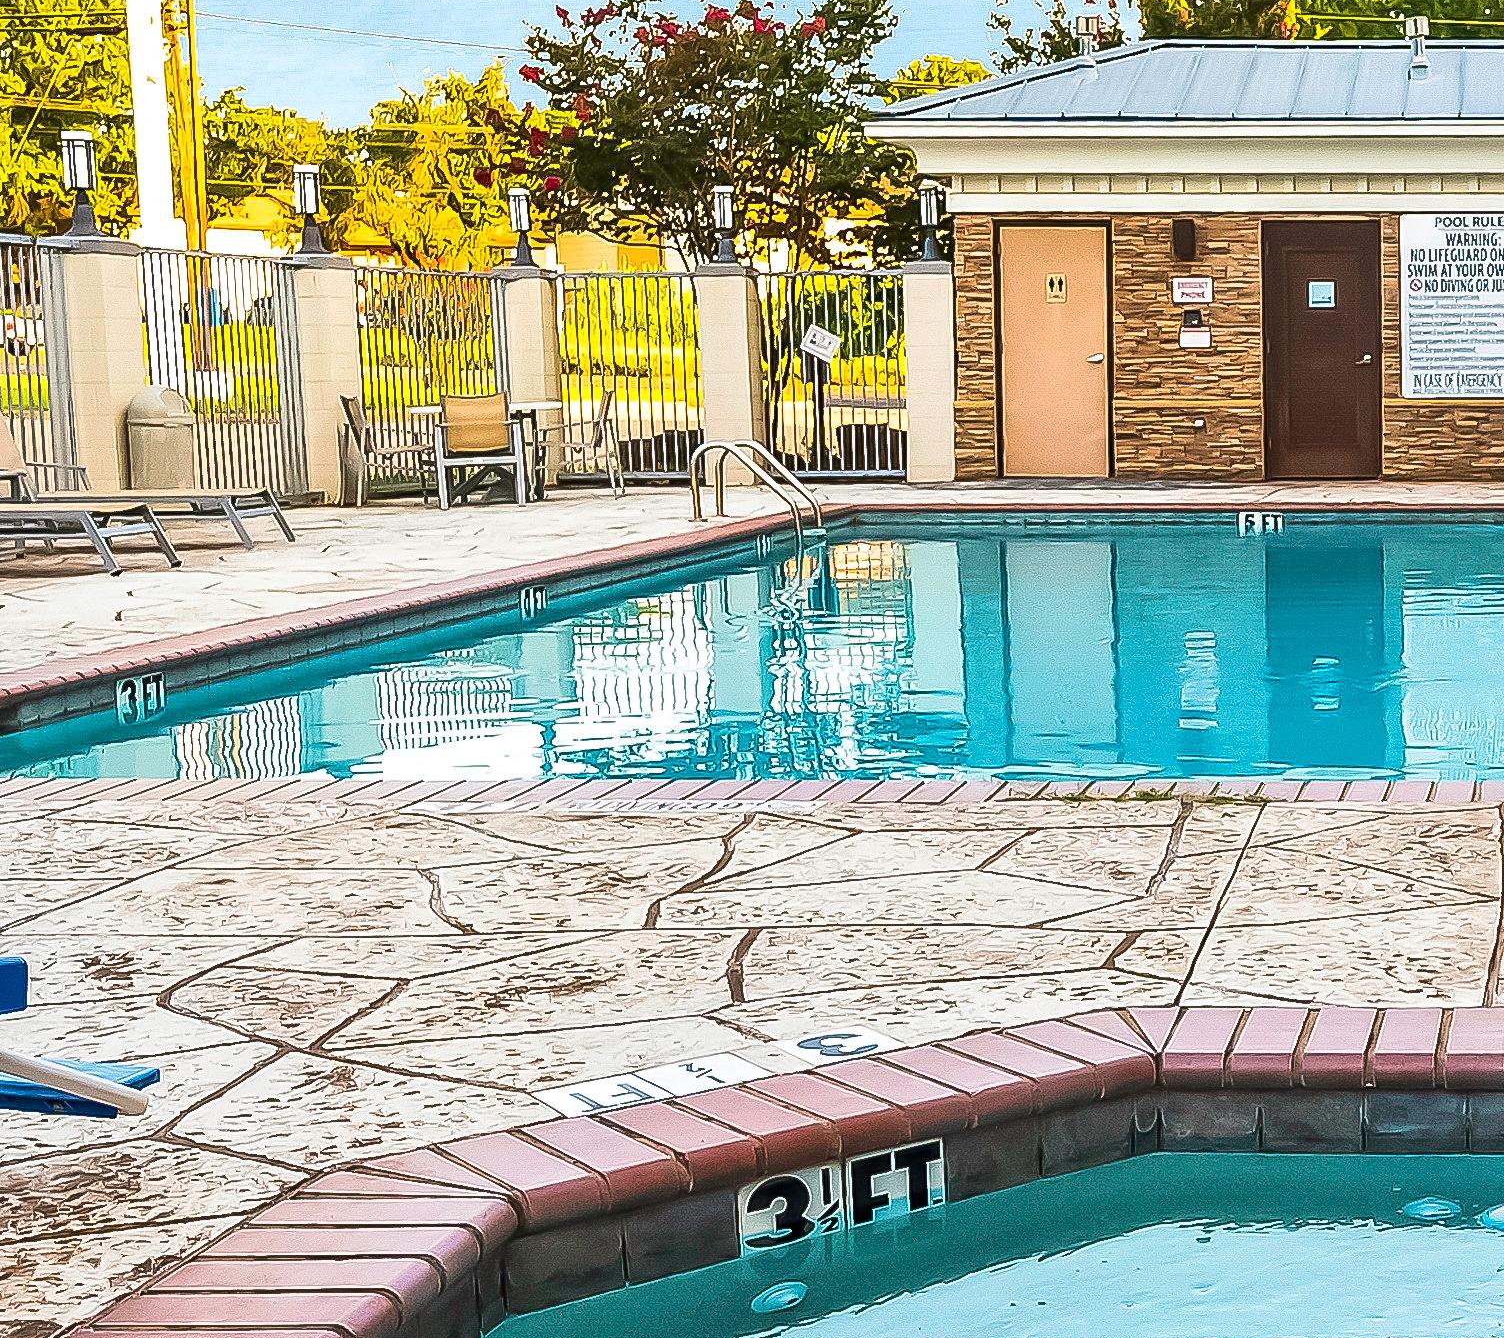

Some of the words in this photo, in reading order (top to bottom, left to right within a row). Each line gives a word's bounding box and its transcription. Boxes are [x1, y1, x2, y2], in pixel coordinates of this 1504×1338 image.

[1435, 217, 1469, 227] POOL
[1445, 232, 1502, 247] WARNING:
[1410, 248, 1426, 262] NO
[1429, 248, 1488, 262] LIFEGUARD
[1407, 263, 1438, 278] SWIM
[1441, 263, 1453, 277] AT
[1455, 263, 1484, 277] YOUR
[1424, 278, 1438, 293] NO
[1441, 278, 1474, 292] DIVING
[1476, 278, 1489, 292] OR
[1261, 514, 1283, 535] FT
[120, 679, 139, 724] 3
[796, 1032, 879, 1057] 3
[745, 1173, 814, 1249] 3
